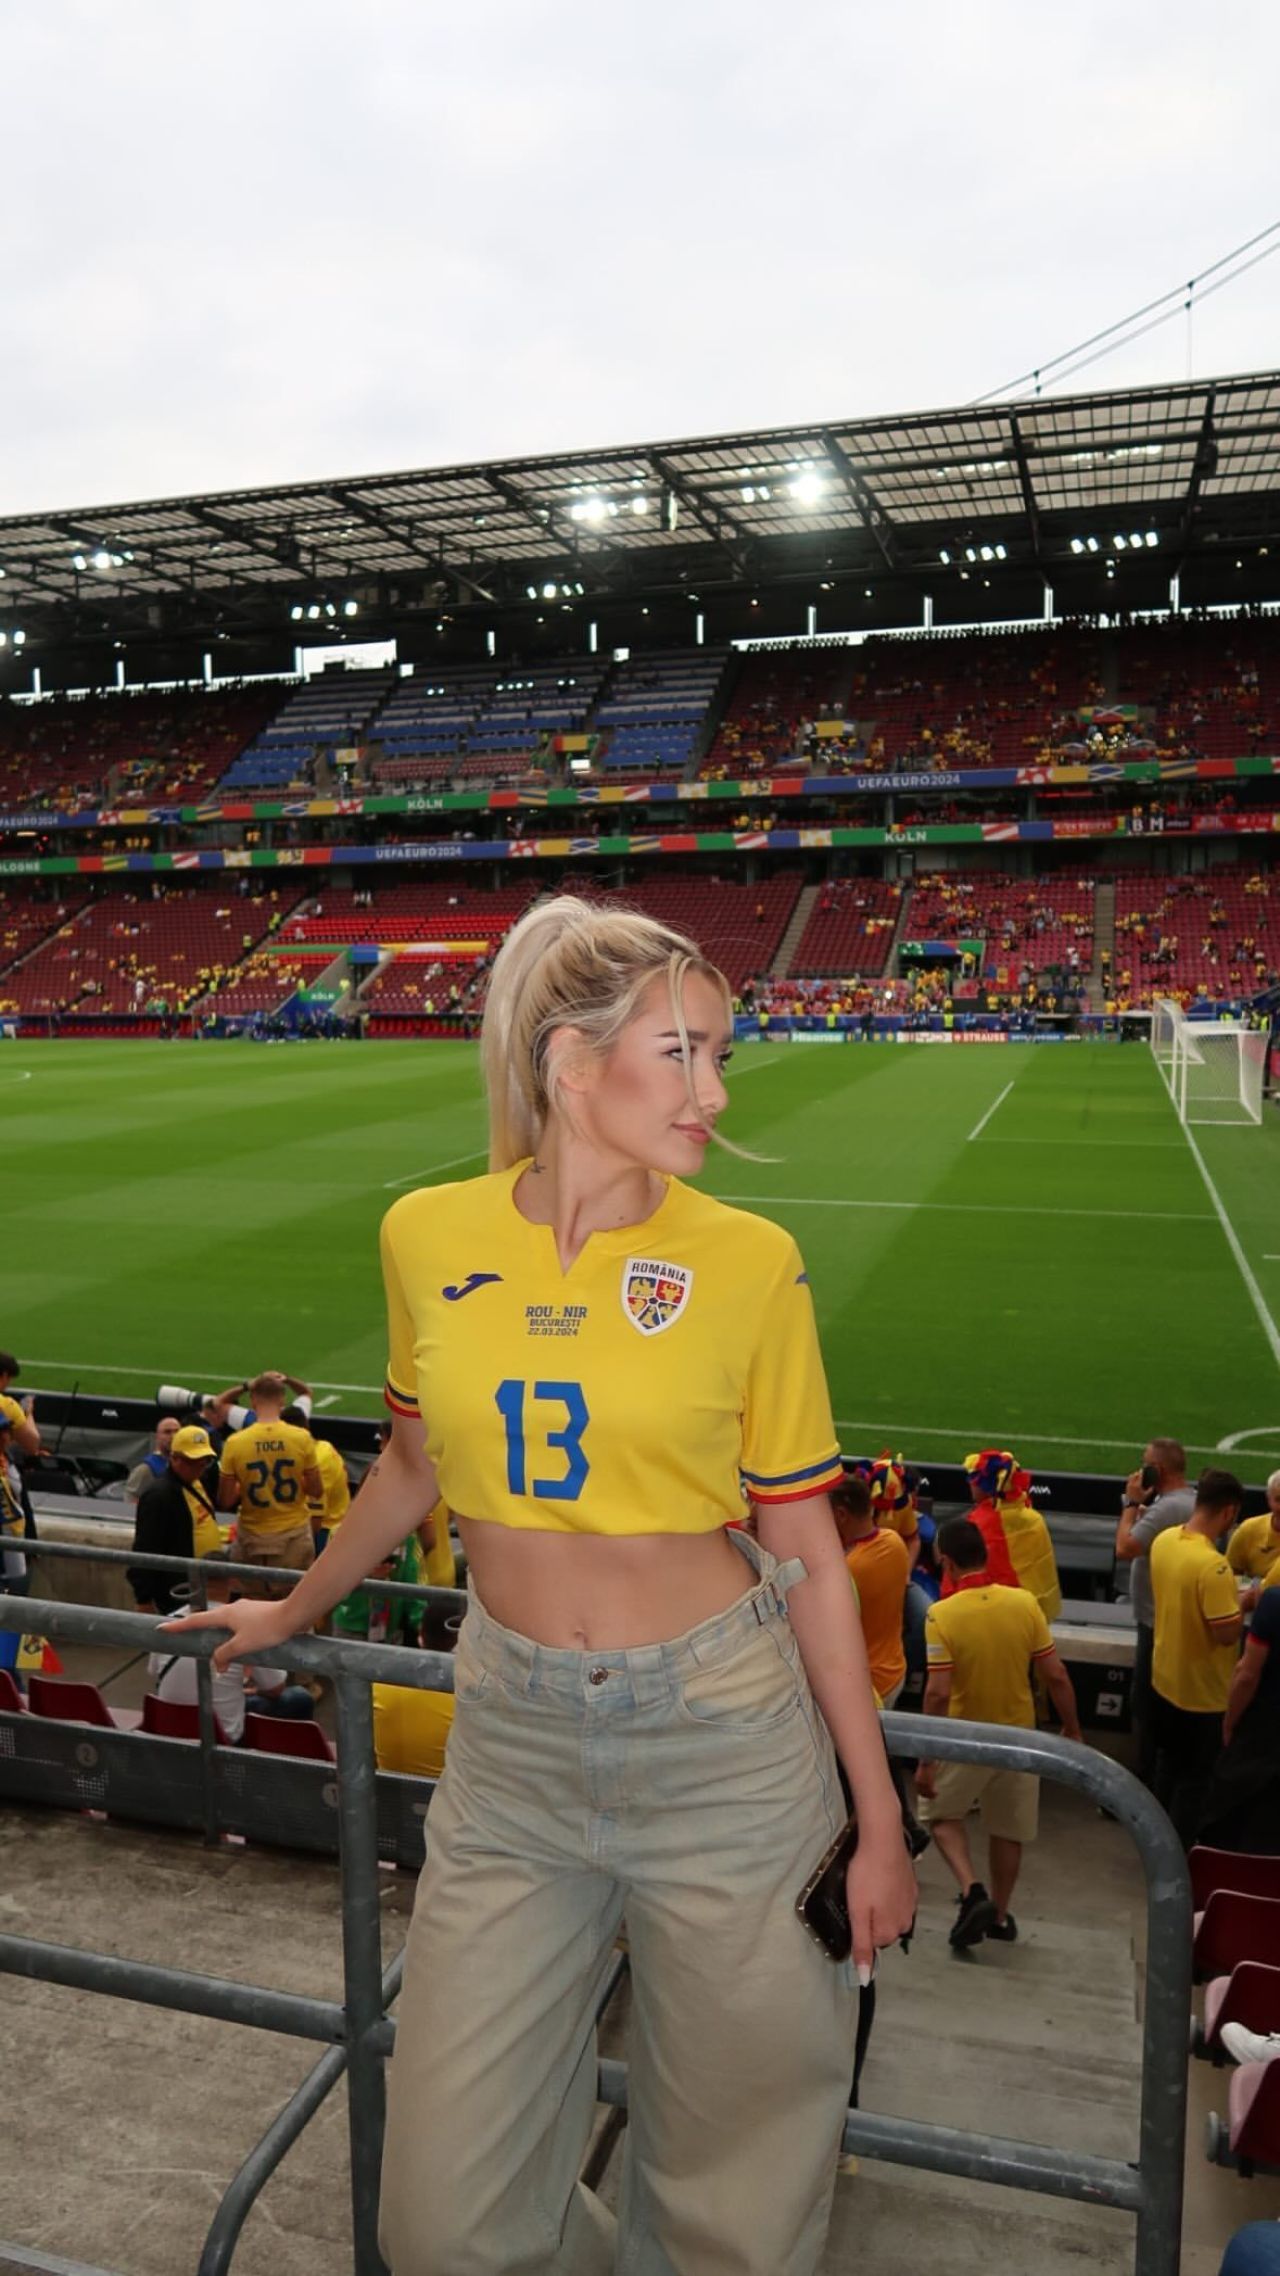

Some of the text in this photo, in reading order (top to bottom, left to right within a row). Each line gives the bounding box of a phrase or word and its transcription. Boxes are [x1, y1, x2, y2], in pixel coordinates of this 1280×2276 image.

[407, 798, 443, 809] KÖLN
[0, 861, 40, 872] LOGNE
[632, 1262, 686, 1283] ROMÂNIA
[525, 1306, 553, 1318] ROU
[563, 1306, 587, 1318] NIR
[527, 1328, 578, 1336] 22.03.2024
[494, 1379, 590, 1501] 13
[246, 1459, 298, 1508] 26
